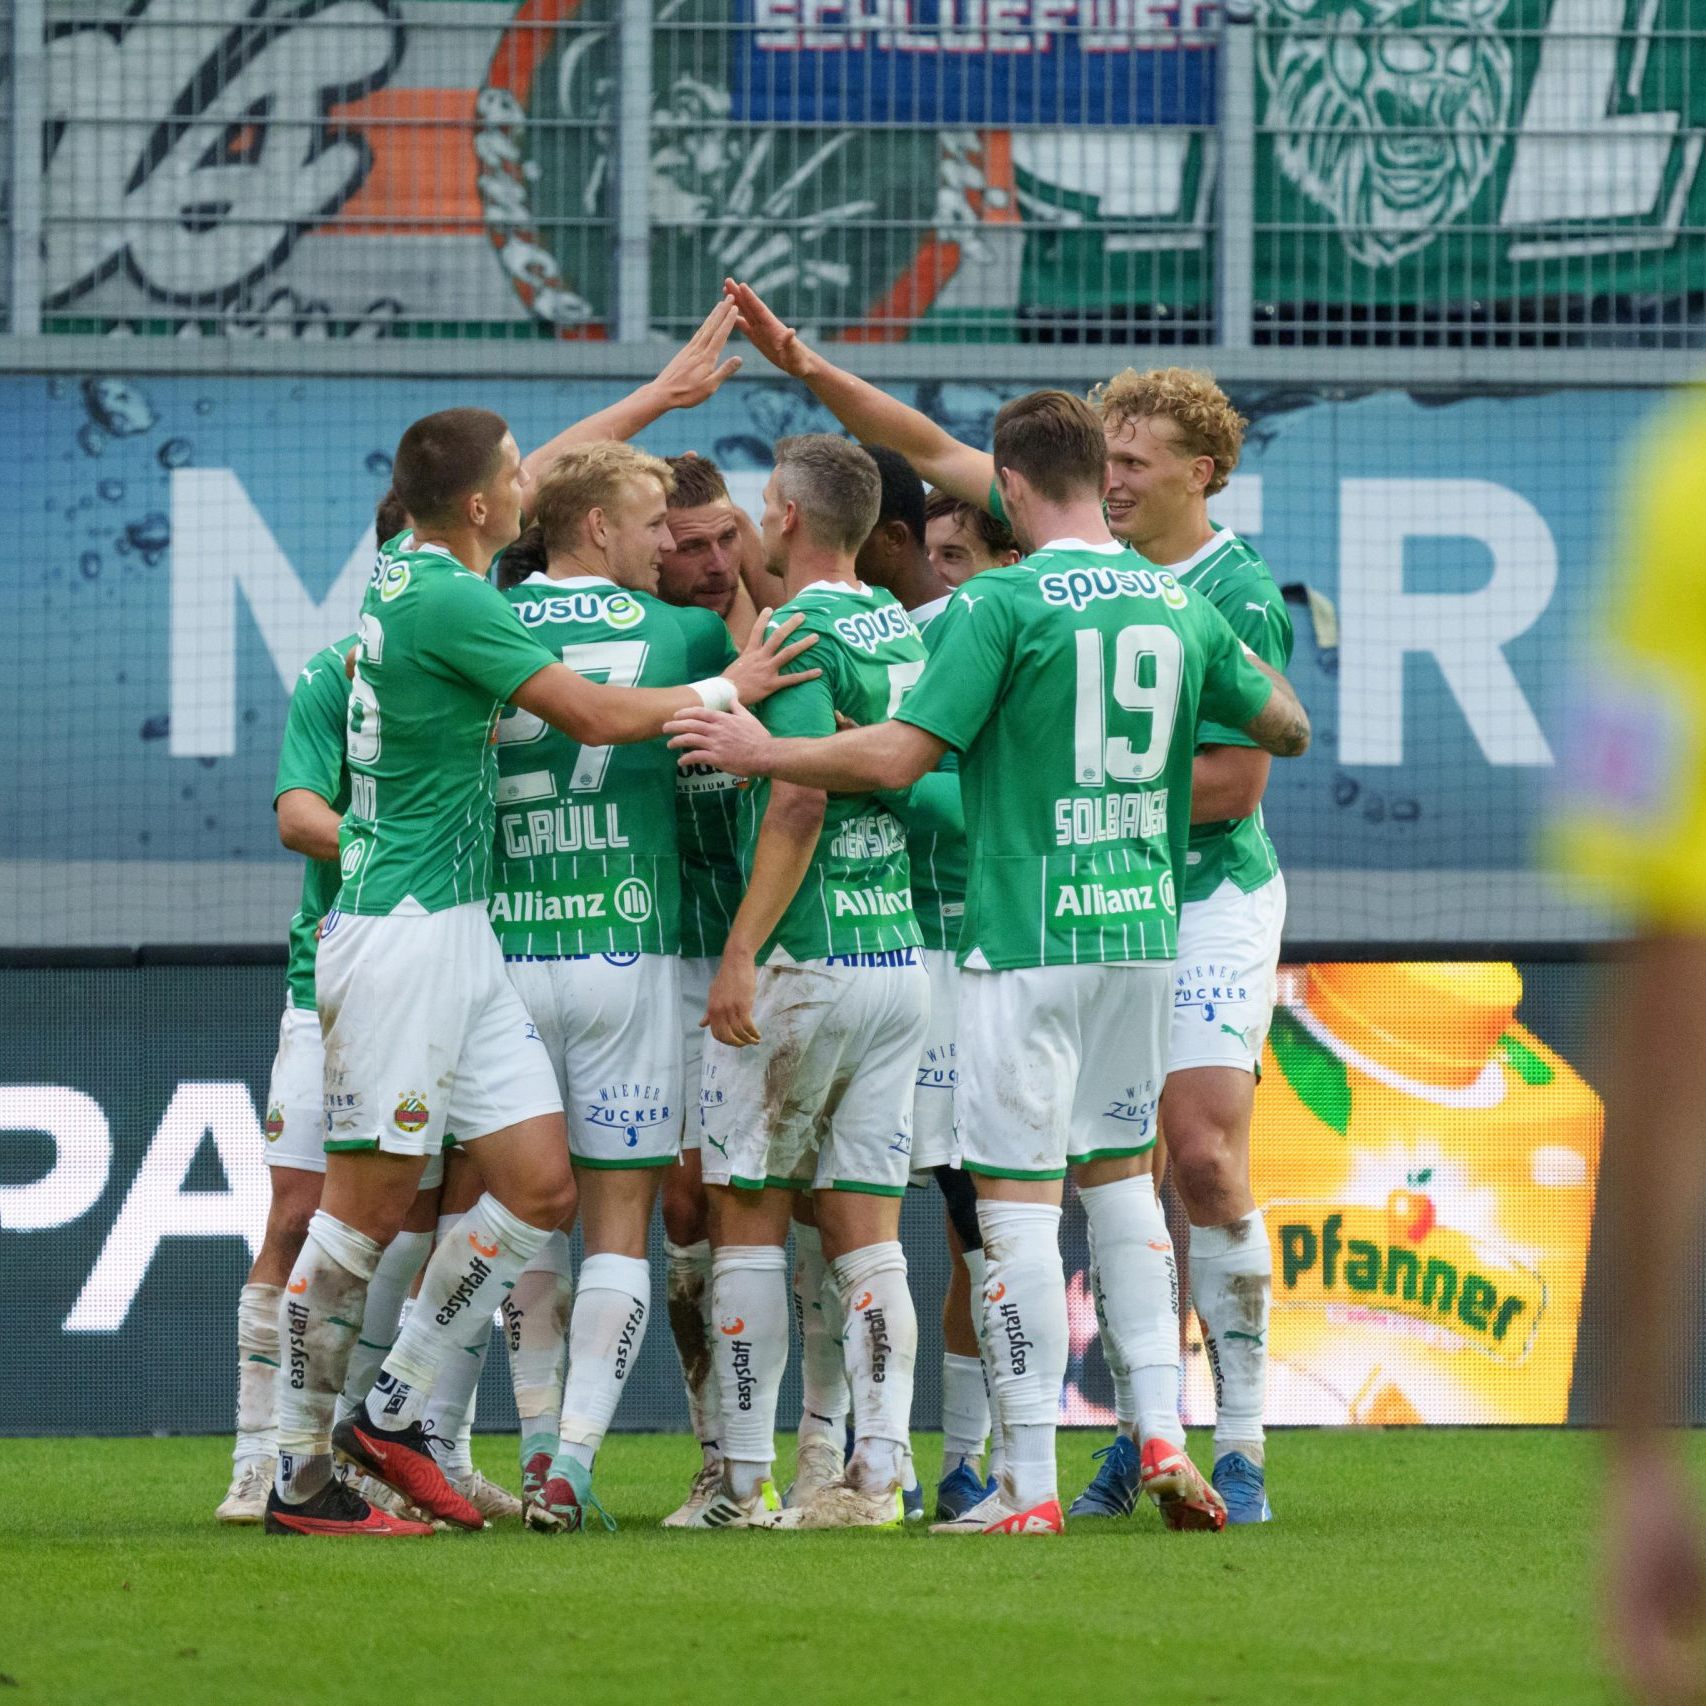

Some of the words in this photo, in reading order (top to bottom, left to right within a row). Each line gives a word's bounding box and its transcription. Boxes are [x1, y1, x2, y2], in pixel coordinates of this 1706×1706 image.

[1042, 569, 1157, 608] spusu
[1074, 624, 1185, 787] 19
[503, 799, 629, 859] GRÜLL
[490, 890, 606, 922] Allianz
[1055, 883, 1156, 917] Allianz
[585, 1104, 670, 1125] ZUCKER
[598, 1083, 661, 1102] WIENER
[436, 1256, 493, 1327] easystaff
[288, 1301, 311, 1390] easystaff
[864, 1306, 892, 1384] easystaff
[1000, 1303, 1033, 1377] easystaff
[731, 1339, 758, 1412] easystaff
